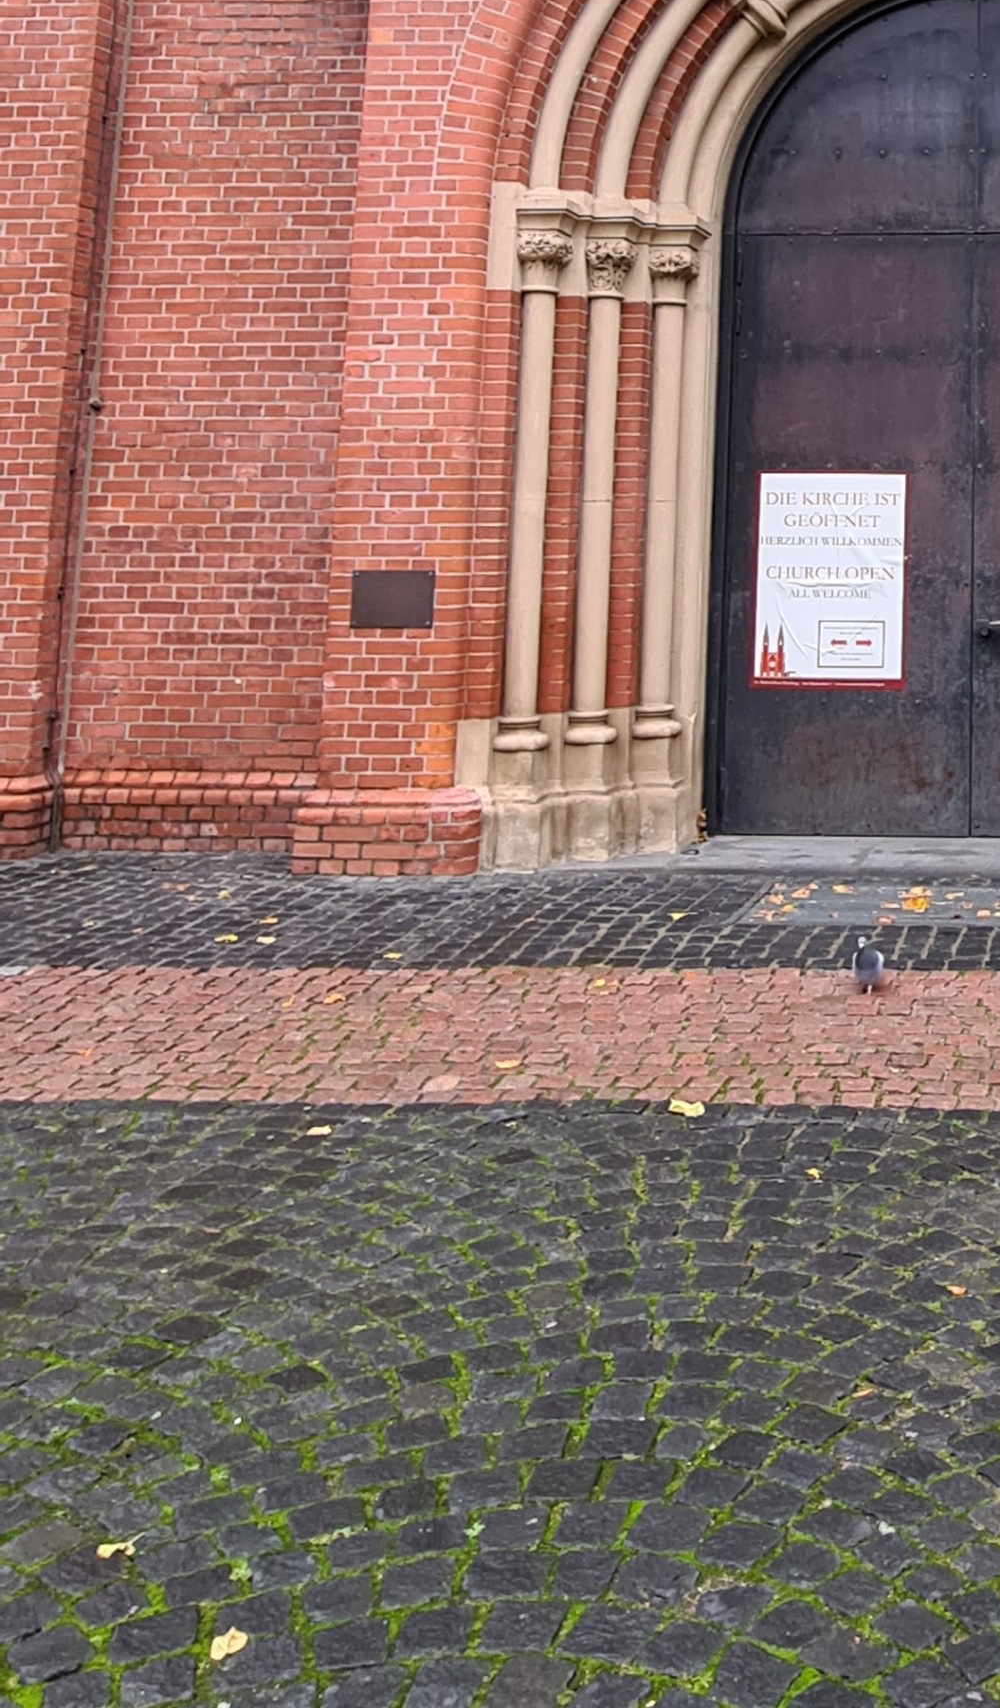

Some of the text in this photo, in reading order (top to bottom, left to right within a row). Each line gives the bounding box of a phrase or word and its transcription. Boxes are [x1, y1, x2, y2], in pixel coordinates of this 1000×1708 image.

[765, 491, 901, 506] DIE KIRCHE IST
[783, 511, 881, 527] GEÖFFNET
[760, 536, 902, 546] HERZLICH WILLKOMMEN
[765, 565, 894, 580] CHURCH OPEN
[788, 589, 871, 599] ALL WELCOME
